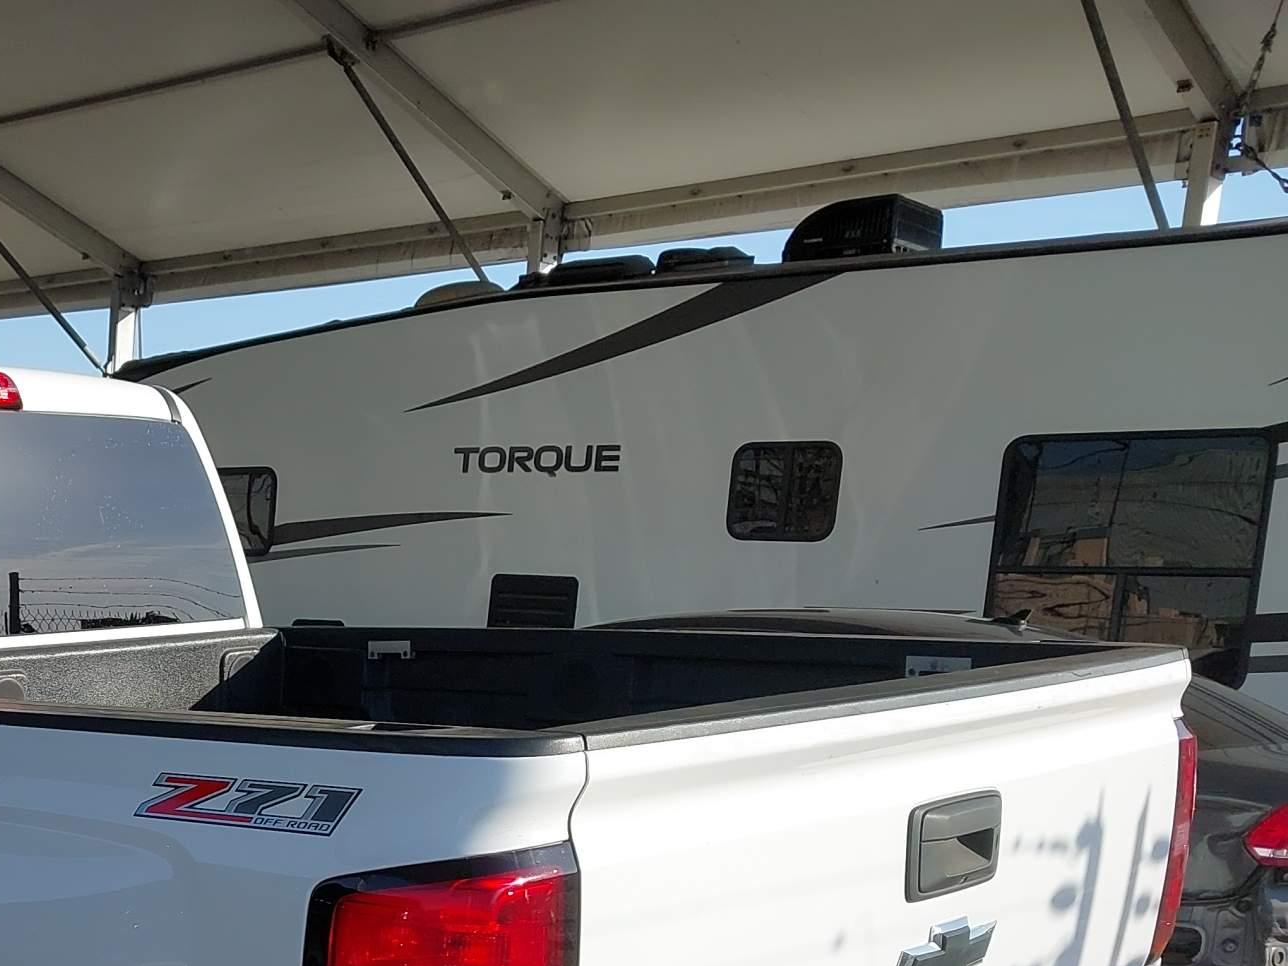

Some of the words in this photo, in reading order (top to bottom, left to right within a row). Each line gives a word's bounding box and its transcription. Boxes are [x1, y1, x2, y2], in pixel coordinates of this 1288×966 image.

[454, 444, 621, 477] TORQUE
[134, 772, 362, 834] Z71
[253, 817, 283, 827] OFF
[286, 820, 331, 832] ROAD
